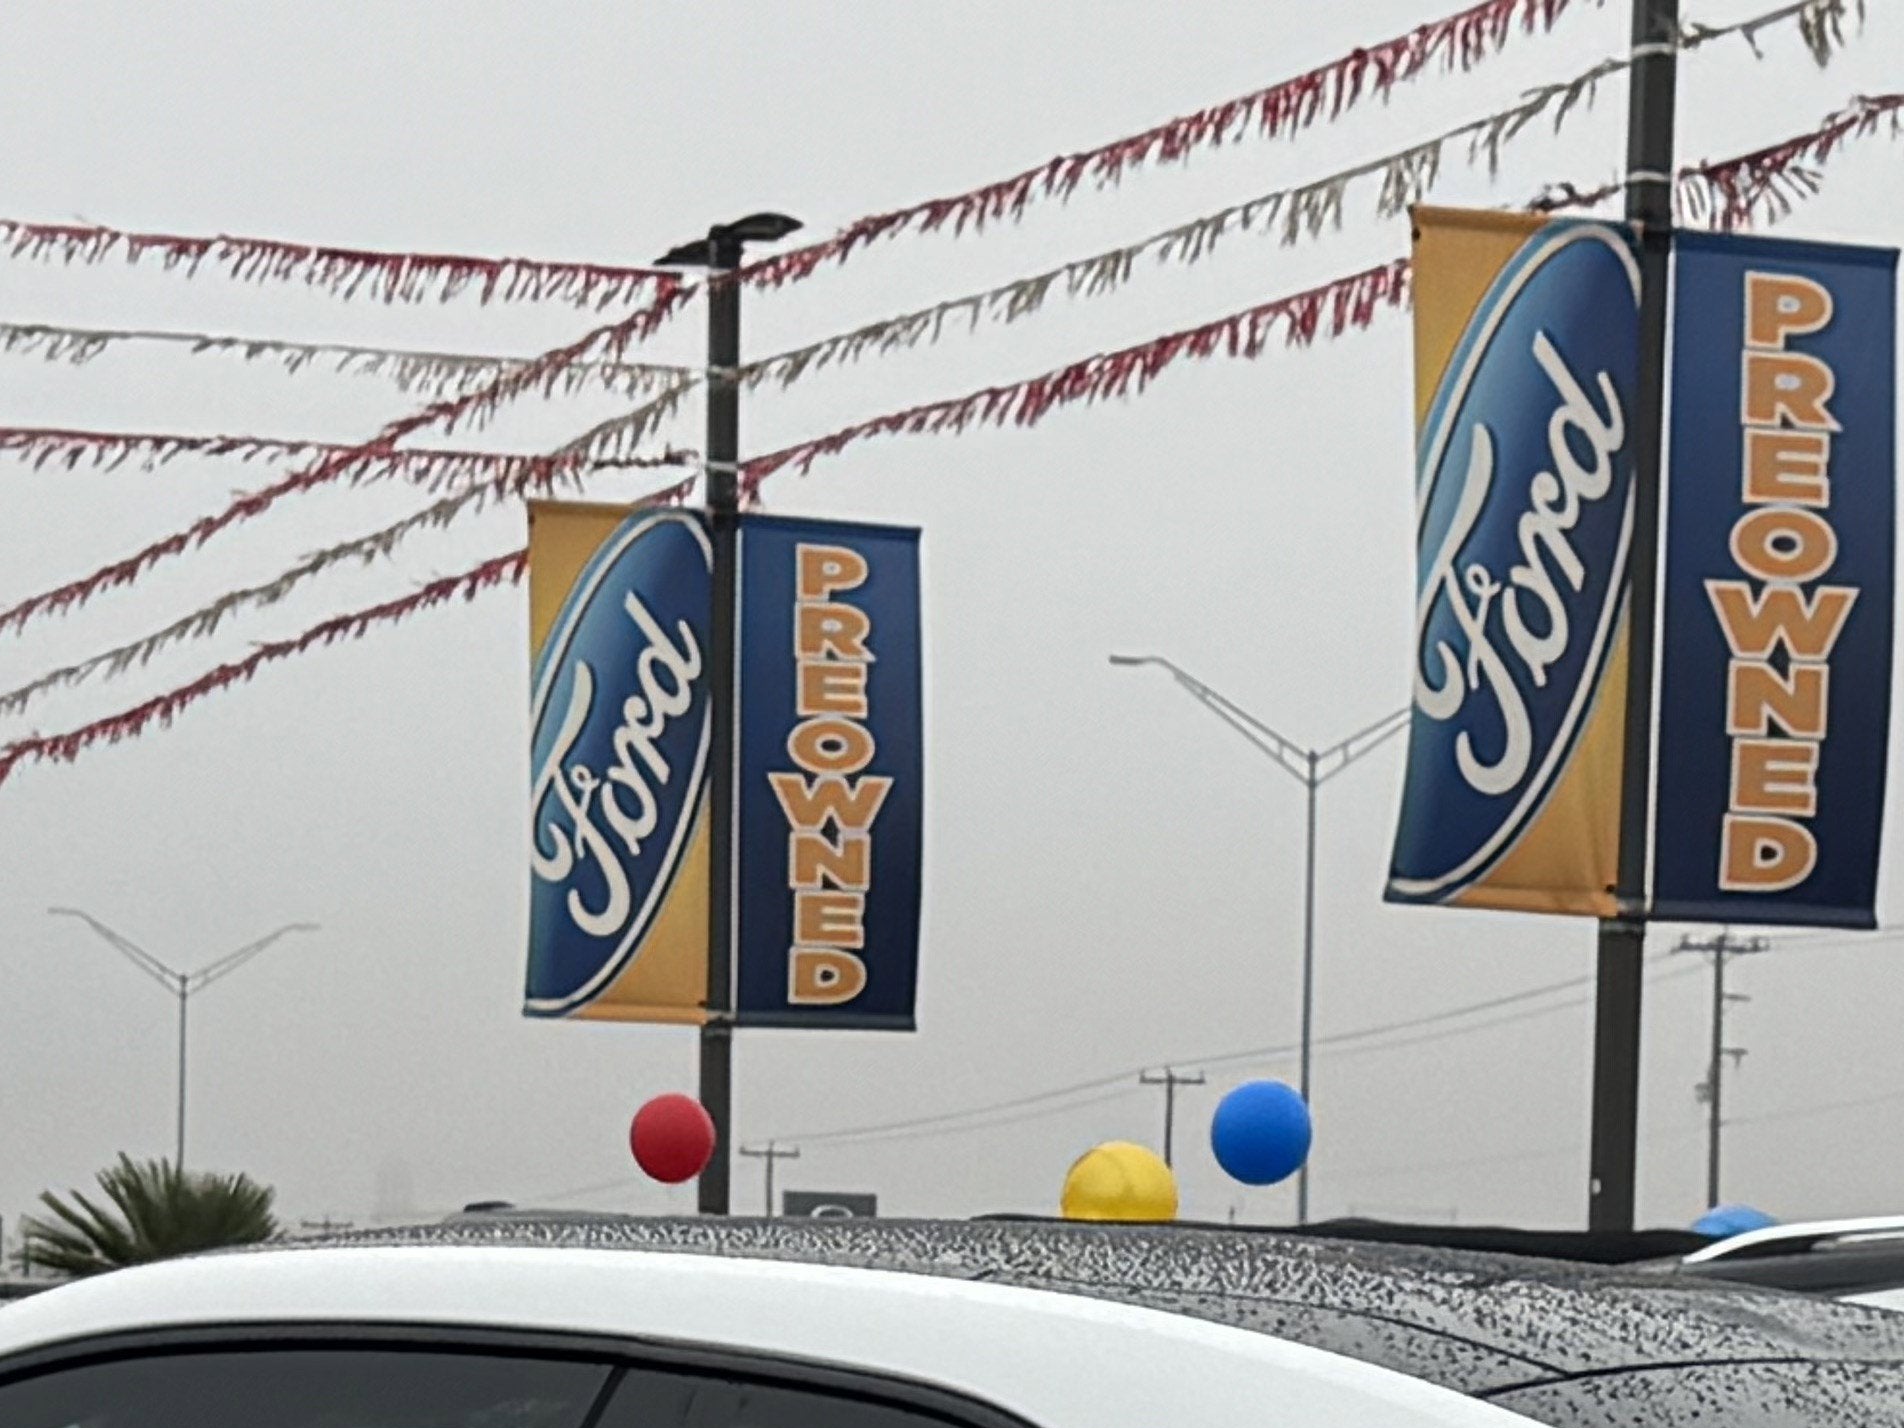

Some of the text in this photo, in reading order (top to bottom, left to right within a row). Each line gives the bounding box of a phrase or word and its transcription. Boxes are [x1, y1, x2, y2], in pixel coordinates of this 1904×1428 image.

[529, 590, 705, 938] Ford
[768, 542, 894, 1006] PREOWNED
[1415, 329, 1626, 795] Ford
[1704, 271, 1861, 892] PREOWNED
